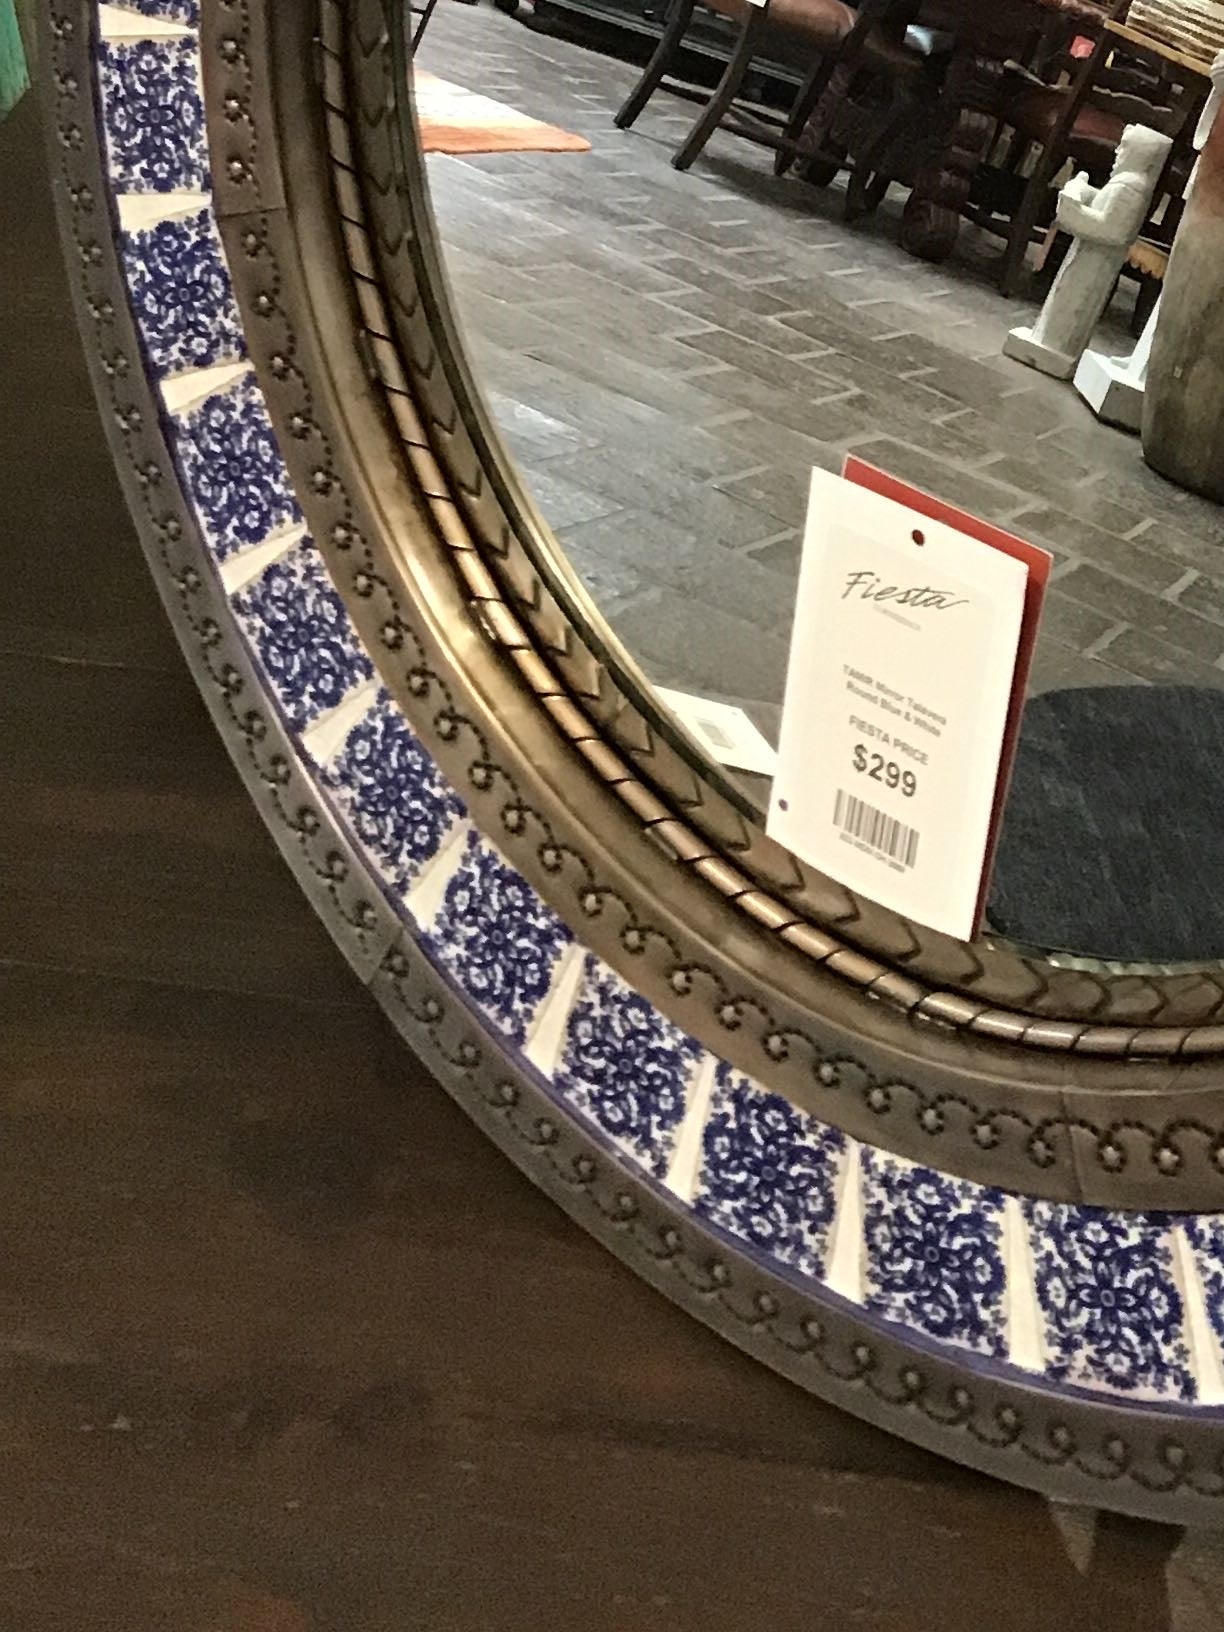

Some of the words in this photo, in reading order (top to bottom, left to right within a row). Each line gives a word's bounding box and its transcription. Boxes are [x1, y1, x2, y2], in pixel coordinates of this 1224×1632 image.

[840, 571, 970, 611] Fiesta
[849, 714, 890, 744] FIESTA
[893, 737, 929, 766] PRICE
[851, 744, 918, 798] $299
